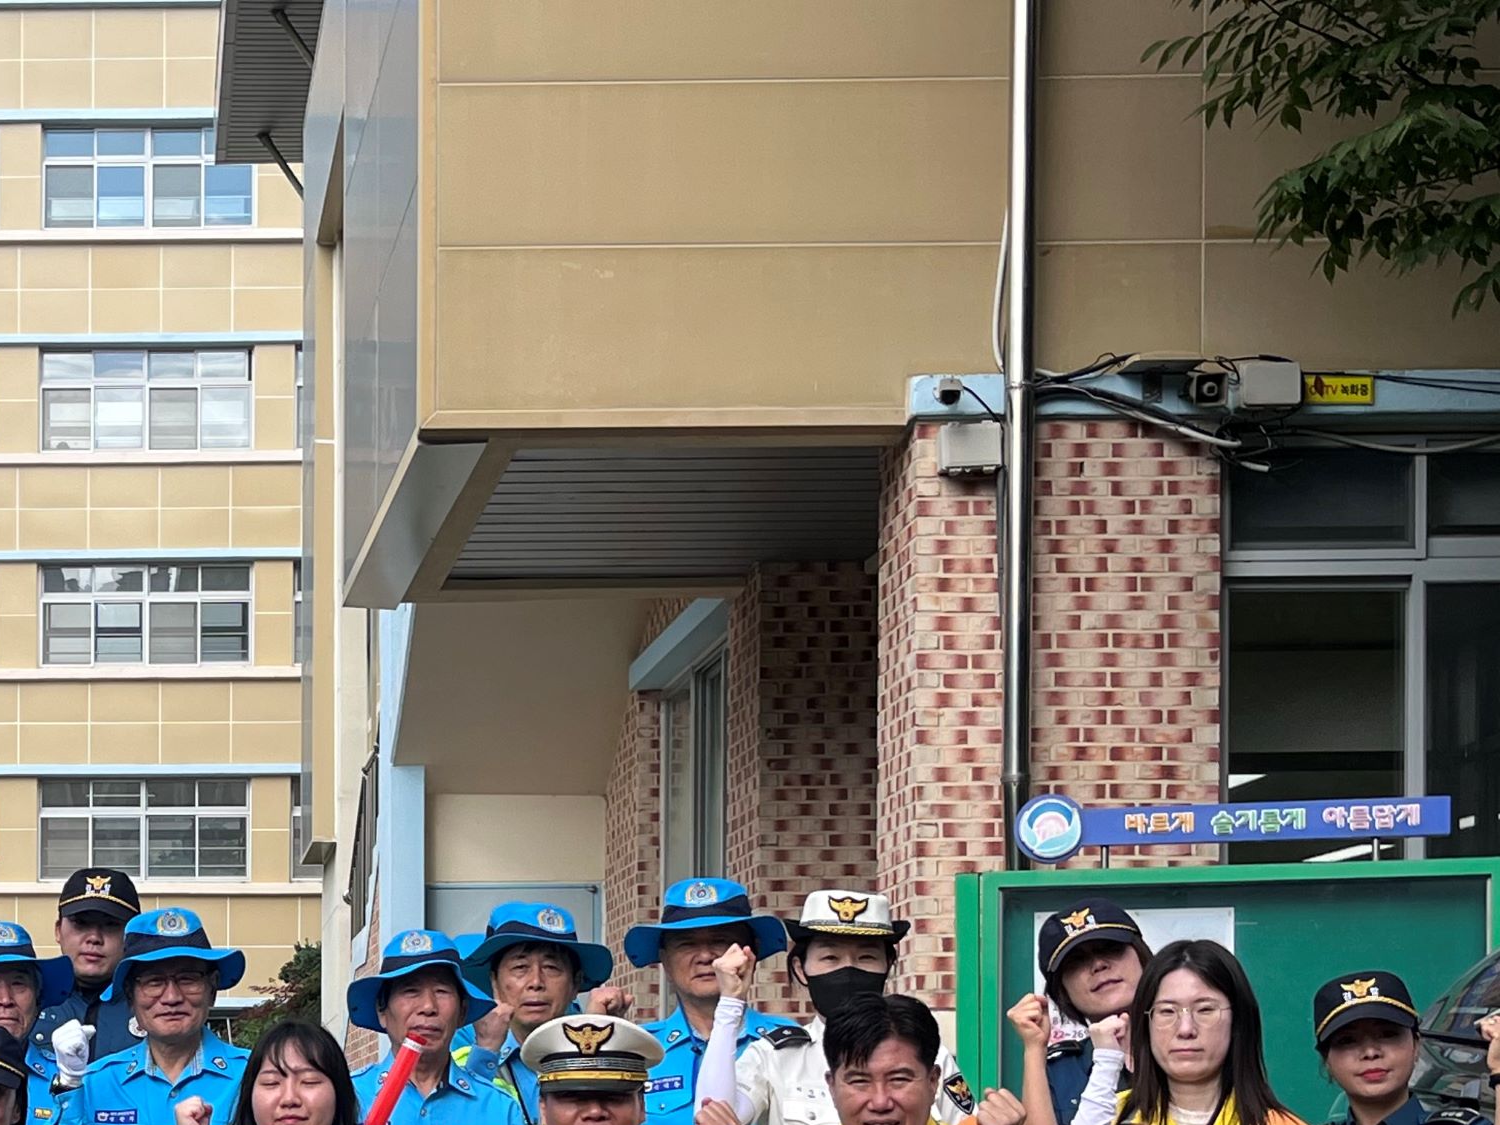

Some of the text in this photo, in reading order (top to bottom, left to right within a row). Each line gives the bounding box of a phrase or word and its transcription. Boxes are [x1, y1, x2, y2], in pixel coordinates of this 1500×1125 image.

[1308, 383, 1338, 396] CTV
[1124, 803, 1421, 834] 바르게 슬기롭게 아름답게
